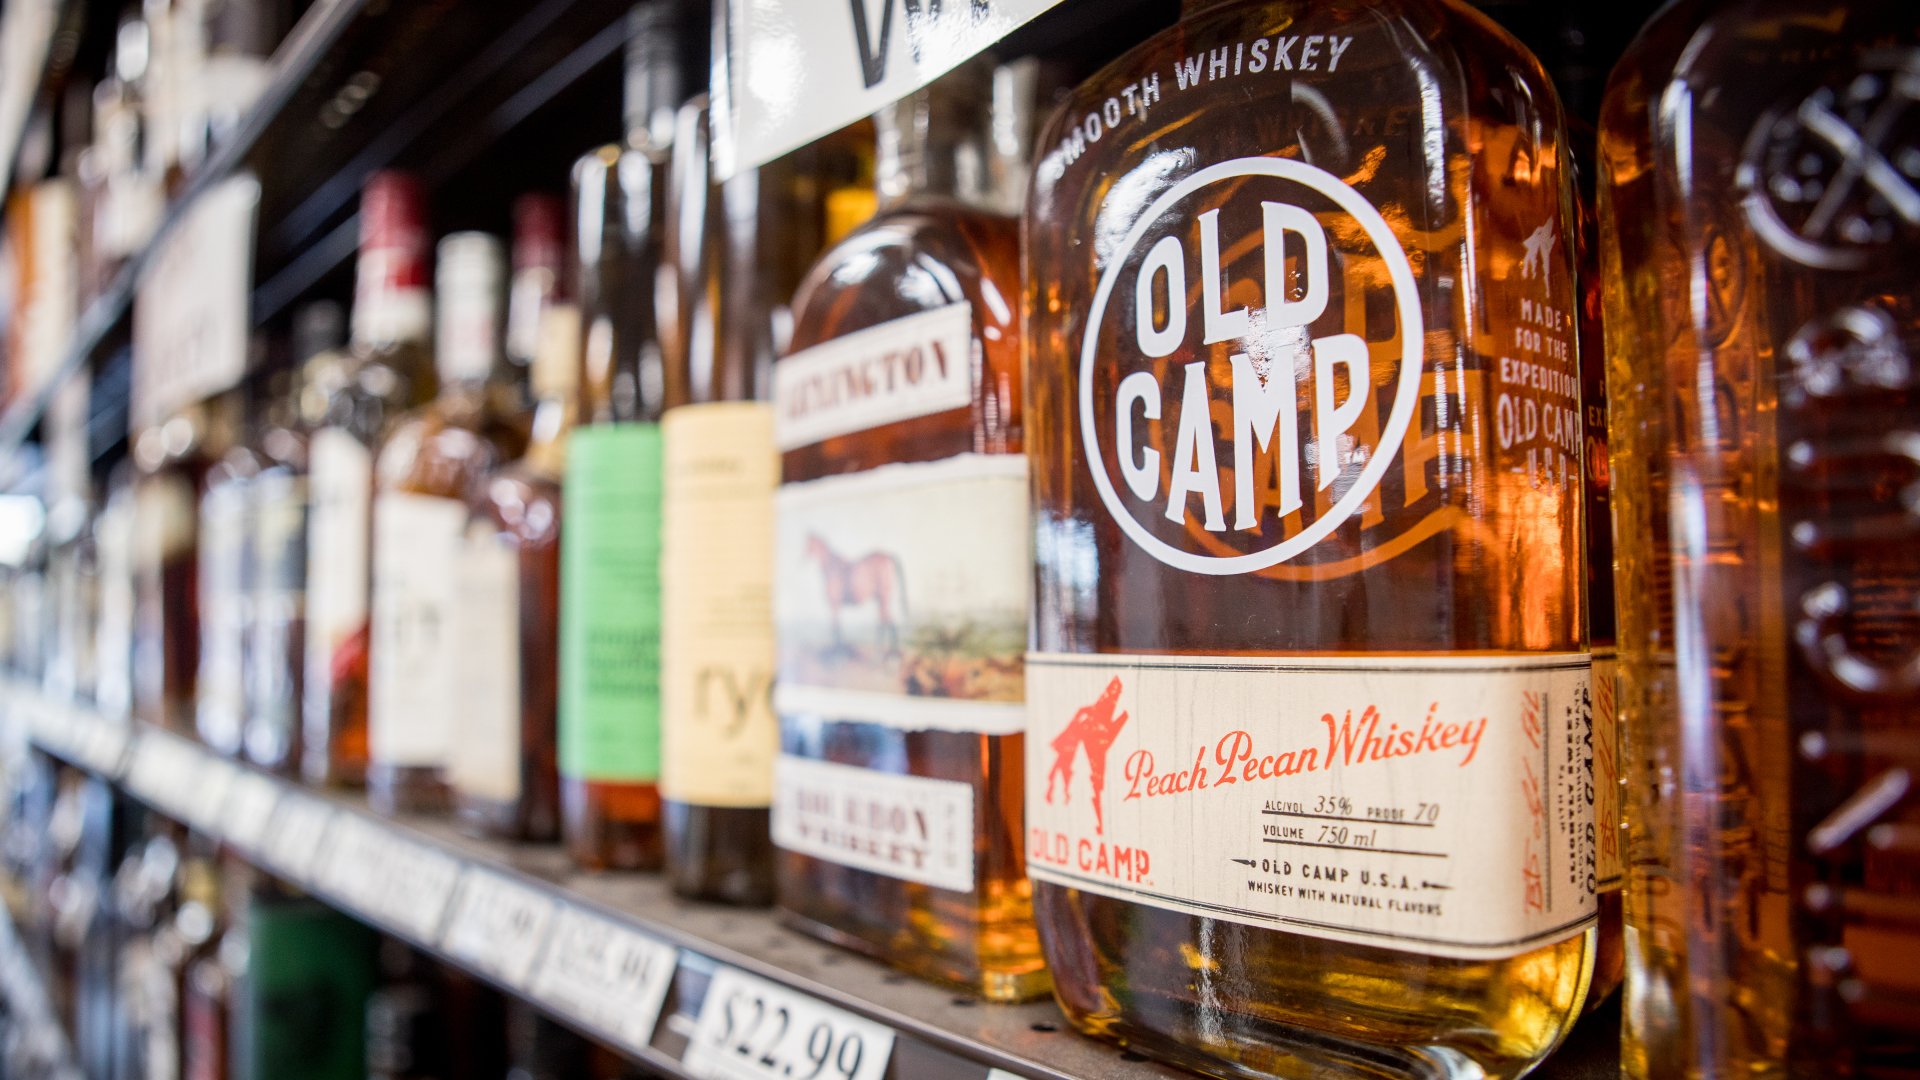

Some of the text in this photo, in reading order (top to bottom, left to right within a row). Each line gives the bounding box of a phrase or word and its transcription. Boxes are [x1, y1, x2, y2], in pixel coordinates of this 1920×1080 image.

[1174, 35, 1353, 91] WHISKEY
[1136, 201, 1329, 358] OLD
[1521, 297, 1562, 332] MADE
[1515, 327, 1567, 362] FOR THE
[1500, 356, 1579, 400] EXPEDITION
[1116, 333, 1370, 532] CAMP
[1497, 392, 1538, 450] OLD
[1123, 701, 1488, 801] Peach Pecan Whiskey
[1265, 796, 1440, 822] ALC/VOL 35% PROOF 70
[1582, 687, 1596, 895] OLD CAMP
[1030, 827, 1150, 884] OLD CAMP
[1263, 825, 1377, 847] VOLUME 750 ml
[1566, 786, 1576, 884] SLIGHTLY
[1576, 822, 1584, 889] SMOOTH
[1248, 880, 1443, 917] WHISKEY WITH NATURAL FLAVORS
[1262, 858, 1418, 892] OLD CAMP U.S.A.
[713, 988, 865, 1080] $22.99
